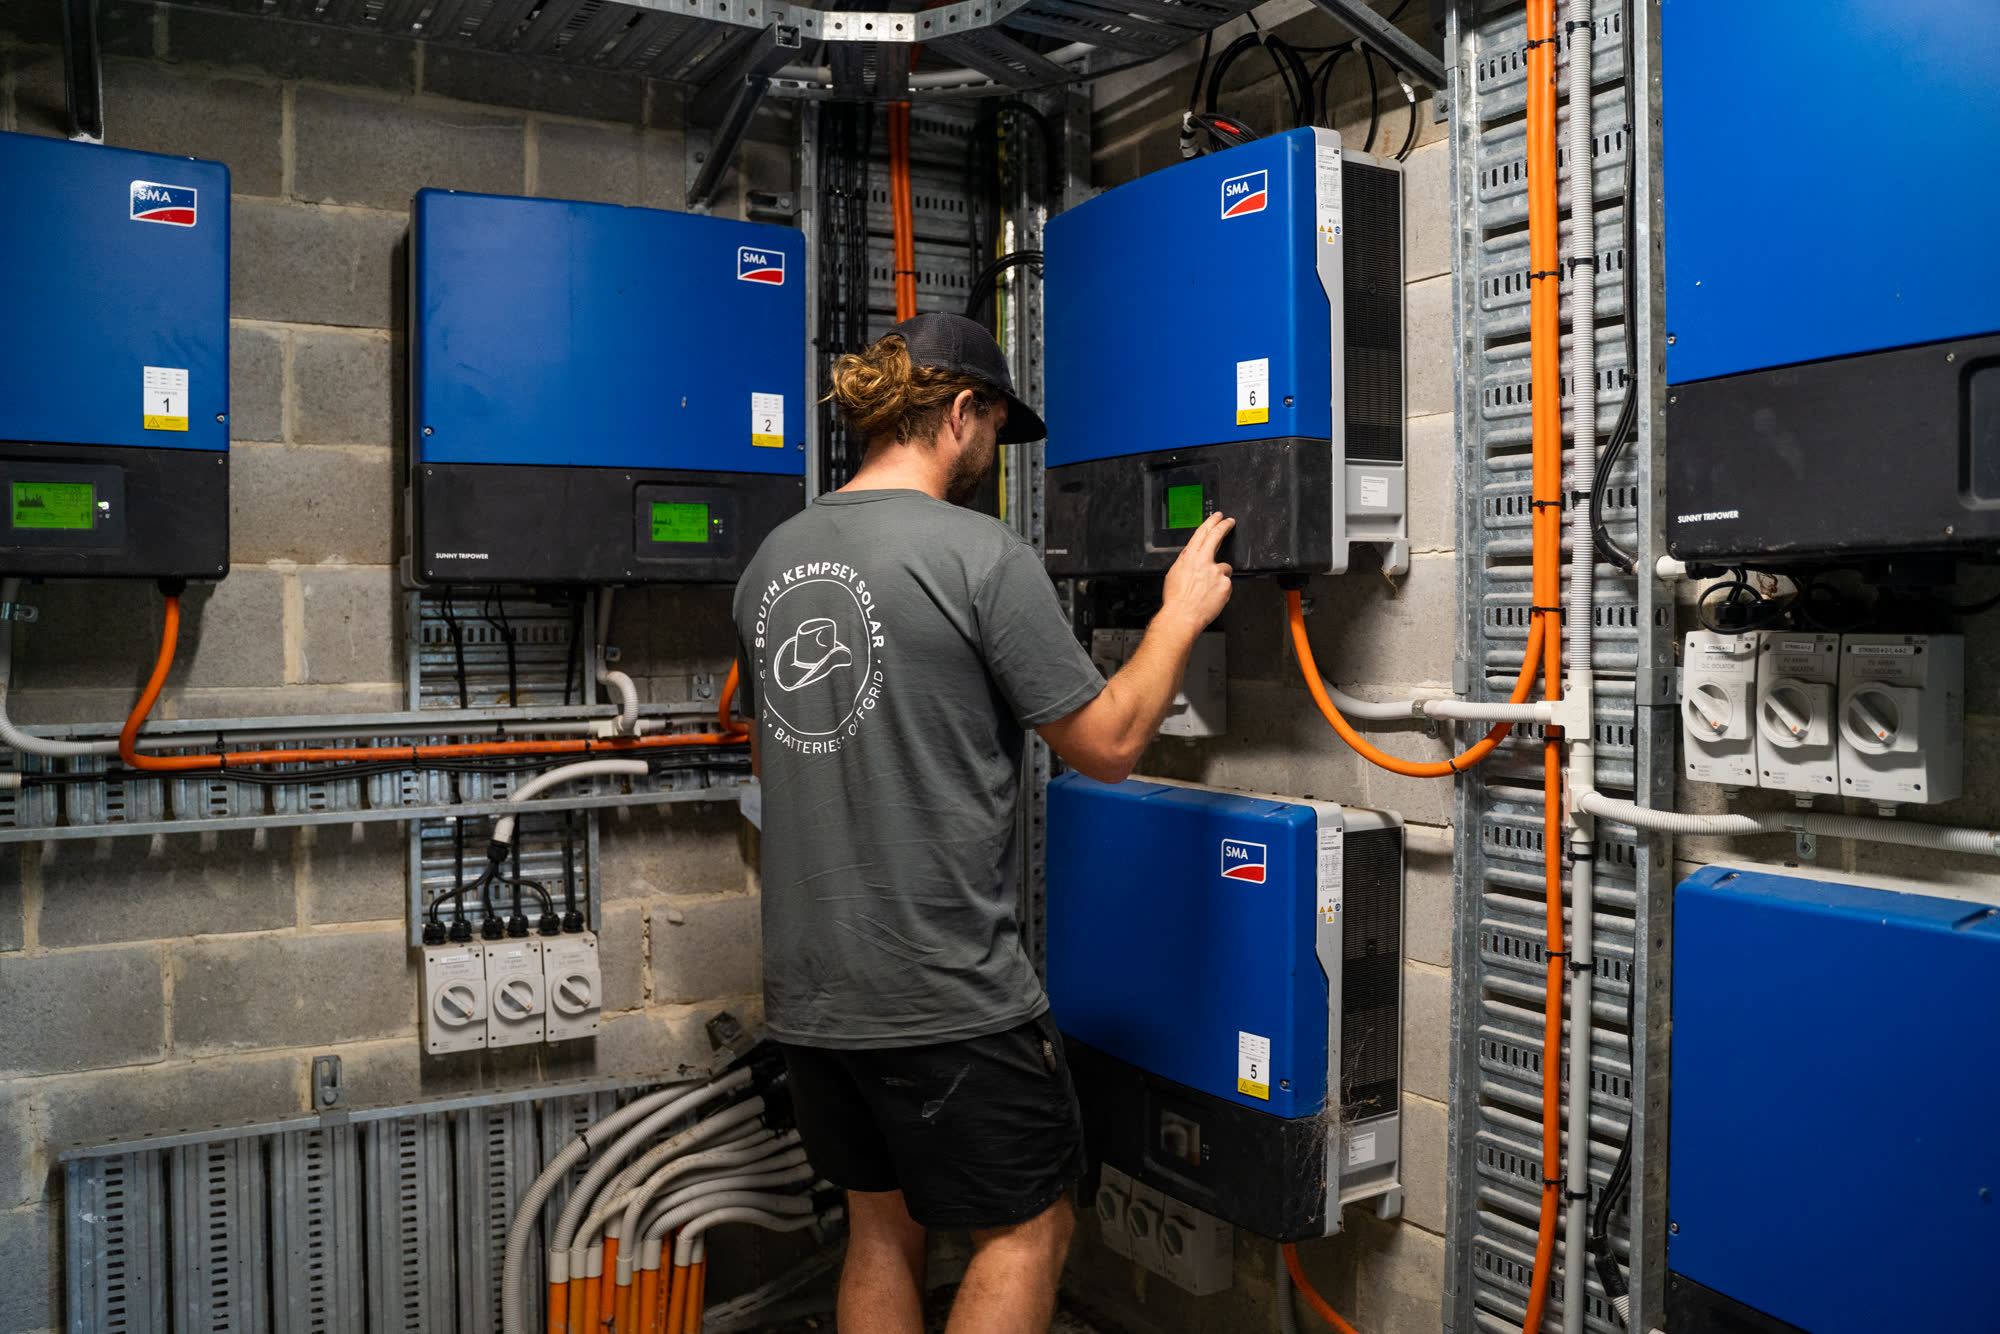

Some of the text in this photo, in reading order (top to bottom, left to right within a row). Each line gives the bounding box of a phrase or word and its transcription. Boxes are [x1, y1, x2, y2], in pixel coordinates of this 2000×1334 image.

[139, 187, 172, 203] SMA
[1226, 181, 1250, 197] SMA
[743, 252, 767, 265] SMA
[163, 397, 169, 413] 1
[1249, 390, 1256, 406] 6
[765, 419, 772, 432] 2
[1678, 510, 1739, 523] SUNNY TRIPOWER
[755, 562, 885, 648] SOUTH KEMPSEY SOLAR
[774, 727, 842, 754] BATTERIES
[1226, 845, 1248, 860] SMA
[1250, 1063, 1257, 1079] 5
